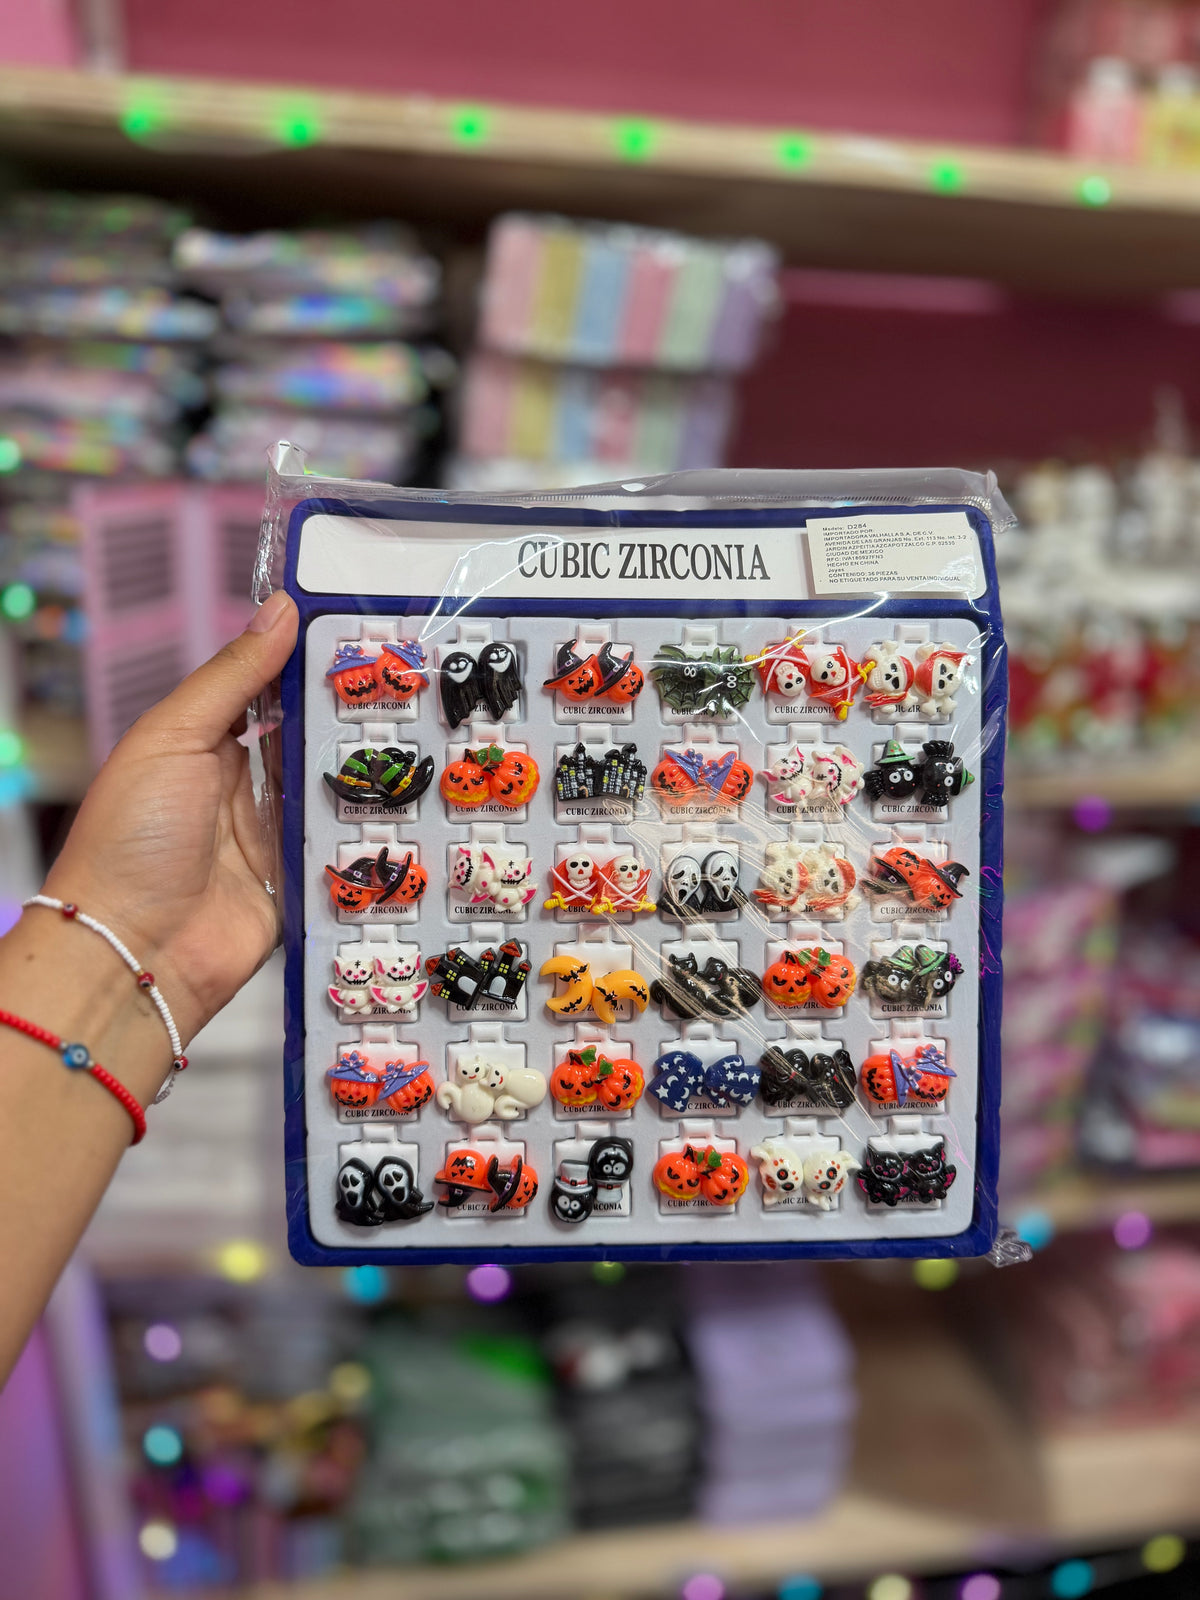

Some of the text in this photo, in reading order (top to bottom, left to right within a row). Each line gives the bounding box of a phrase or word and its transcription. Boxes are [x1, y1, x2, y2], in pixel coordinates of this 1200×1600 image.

[824, 534, 868, 542] IMPORTADORA
[518, 541, 771, 580] CUBIC ZIRCONIA
[347, 701, 411, 710] CUBIC ZIRCONIA
[775, 705, 798, 714] CUBIC
[563, 706, 625, 715] CUBIC ZIRCONIA
[344, 806, 407, 815] CUBIC ZIRCONIA
[481, 805, 518, 813] ZIRCONIA
[566, 807, 589, 816] CUBIC
[670, 806, 693, 815] CUBIC
[882, 805, 942, 813] CUBIC ZIRCONIA
[370, 906, 408, 914] ZIRCONIA
[455, 906, 477, 914] CUBIC
[880, 906, 905, 915] CUBIC
[481, 1003, 518, 1011] ZIRCONIA
[882, 1004, 905, 1012] CUBIC
[345, 1109, 369, 1118] CUBIC
[457, 1203, 480, 1211] CUBIC
[668, 1199, 690, 1208] CUBIC
